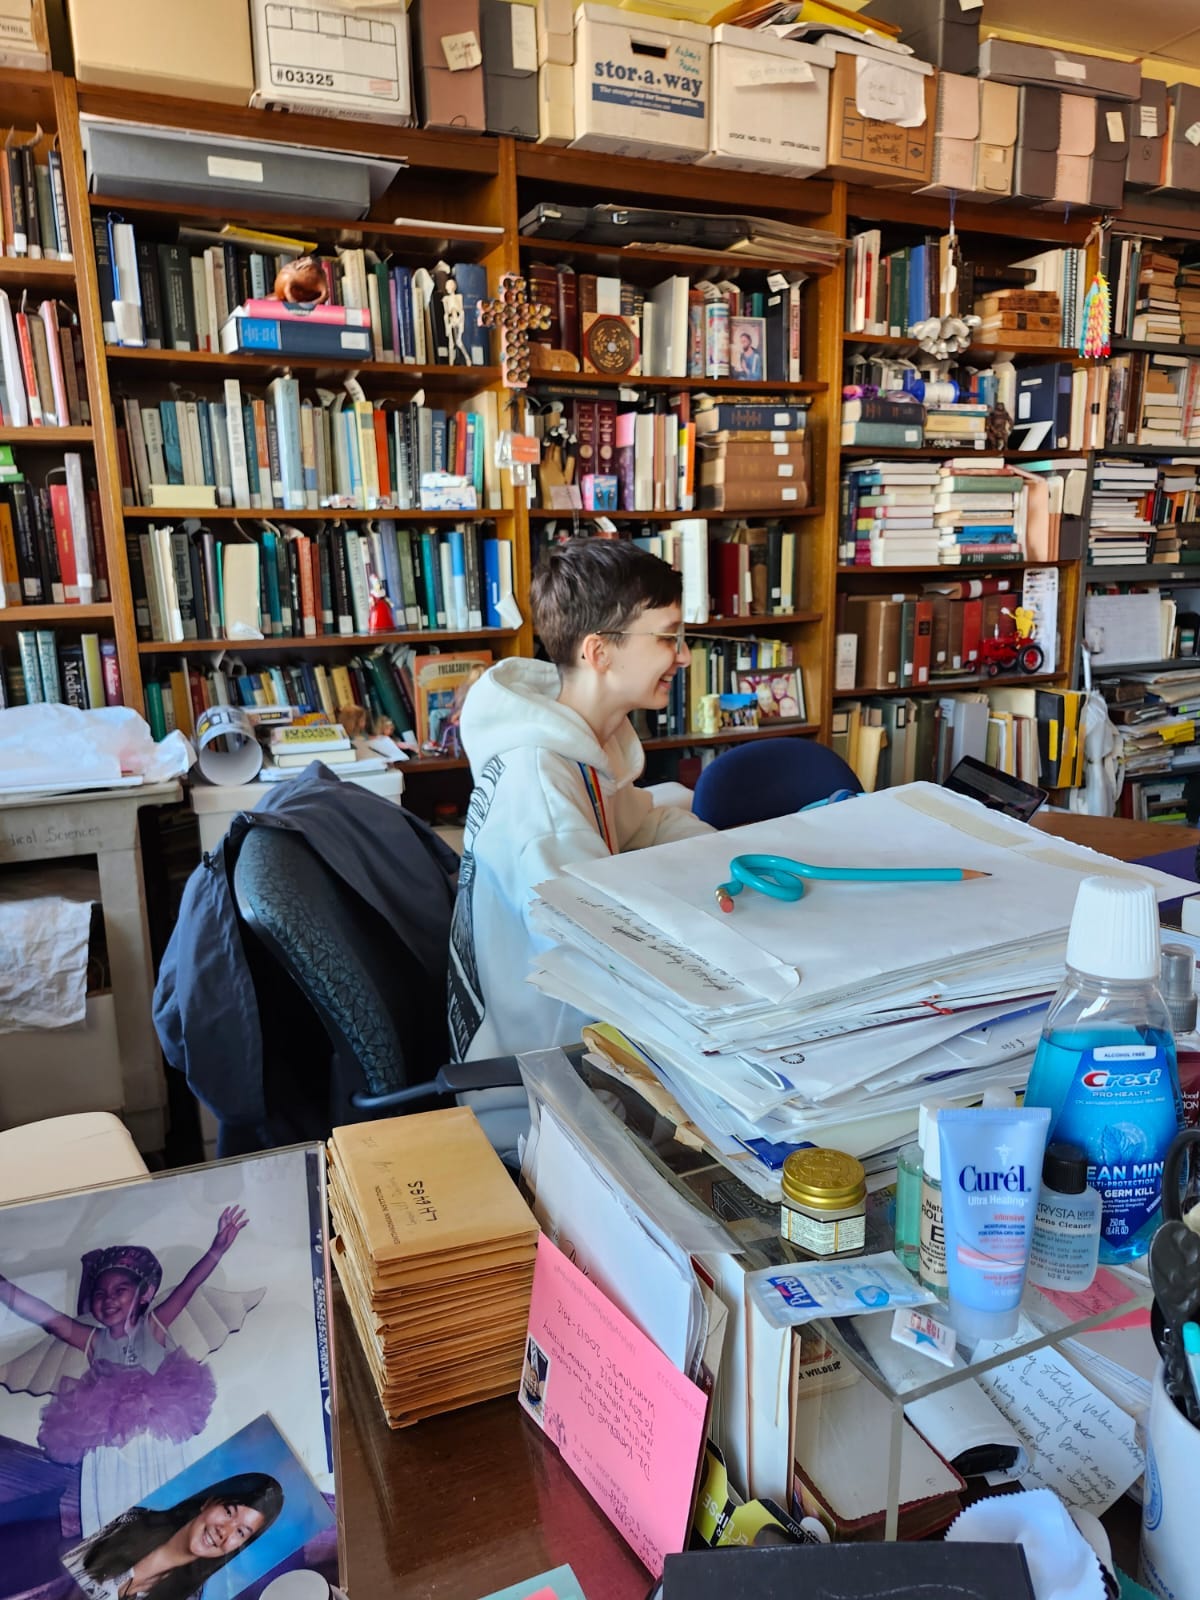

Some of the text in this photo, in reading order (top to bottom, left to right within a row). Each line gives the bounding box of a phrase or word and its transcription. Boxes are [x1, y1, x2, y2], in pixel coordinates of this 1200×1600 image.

[276, 69, 335, 87] #03325
[105, 657, 119, 696] Medicine
[1082, 1068, 1162, 1089] Crest
[1133, 1161, 1165, 1179] MIN
[959, 1165, 1025, 1193] Curél
[1087, 1178, 1156, 1188] ULTI-PROTECTION
[968, 1195, 988, 1206] Ultra
[1104, 1187, 1155, 1198] GERM KILL
[1035, 1214, 1092, 1229] Lens Cleaner
[1109, 1218, 1118, 1227] 250
[777, 1277, 812, 1306] Purell
[805, 1361, 841, 1378] WILDER
[786, 1521, 803, 1538] 2017
